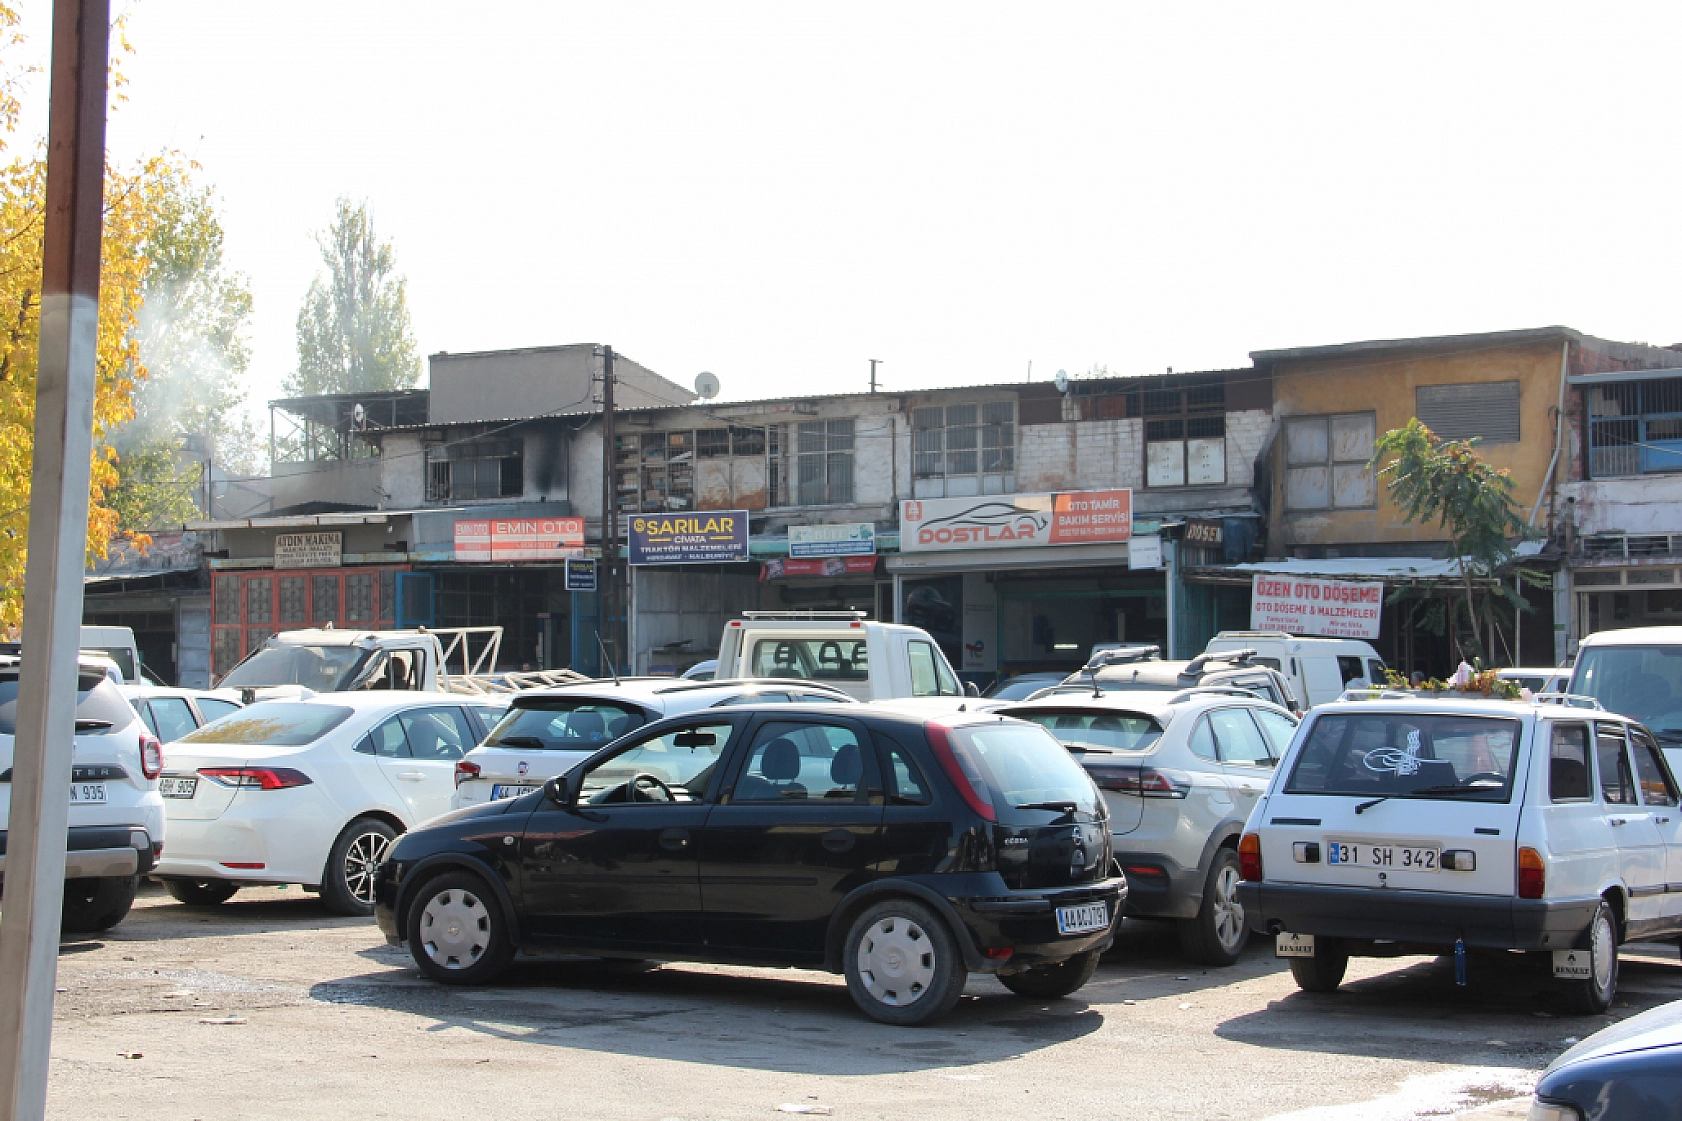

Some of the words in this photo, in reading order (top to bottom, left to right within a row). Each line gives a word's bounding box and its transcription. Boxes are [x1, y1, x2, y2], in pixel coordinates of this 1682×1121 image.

[1068, 501, 1088, 512] OTO
[1090, 497, 1120, 511] TAMİR
[1059, 514, 1089, 526] BAKIM
[1091, 510, 1129, 525] SERVİSİ
[473, 522, 489, 535] OTO
[542, 520, 579, 534] OTO
[647, 517, 734, 535] SARILAR
[276, 535, 304, 548] AYDIN
[674, 535, 706, 545] CİVATA
[919, 524, 1036, 545] DOSTLAR
[640, 545, 681, 554] TRAKTÖR
[682, 543, 742, 552] MALZEMELERİ
[1257, 577, 1291, 598] ÖZEN
[1295, 583, 1320, 600] OTO
[1323, 583, 1380, 604] DÖŞEME
[1255, 602, 1272, 612] OTO
[1274, 602, 1308, 615] DÖŞEME
[1309, 607, 1315, 615] &
[1318, 605, 1378, 619] MALZEMELERİ
[74, 769, 109, 777] TER
[83, 785, 104, 800] 935
[178, 780, 194, 793] 905
[1340, 845, 1358, 863] 31
[1372, 848, 1392, 866] SH
[1402, 849, 1435, 868] 342
[1280, 945, 1313, 953] RENAULT
[1555, 966, 1589, 974] RENAULT
